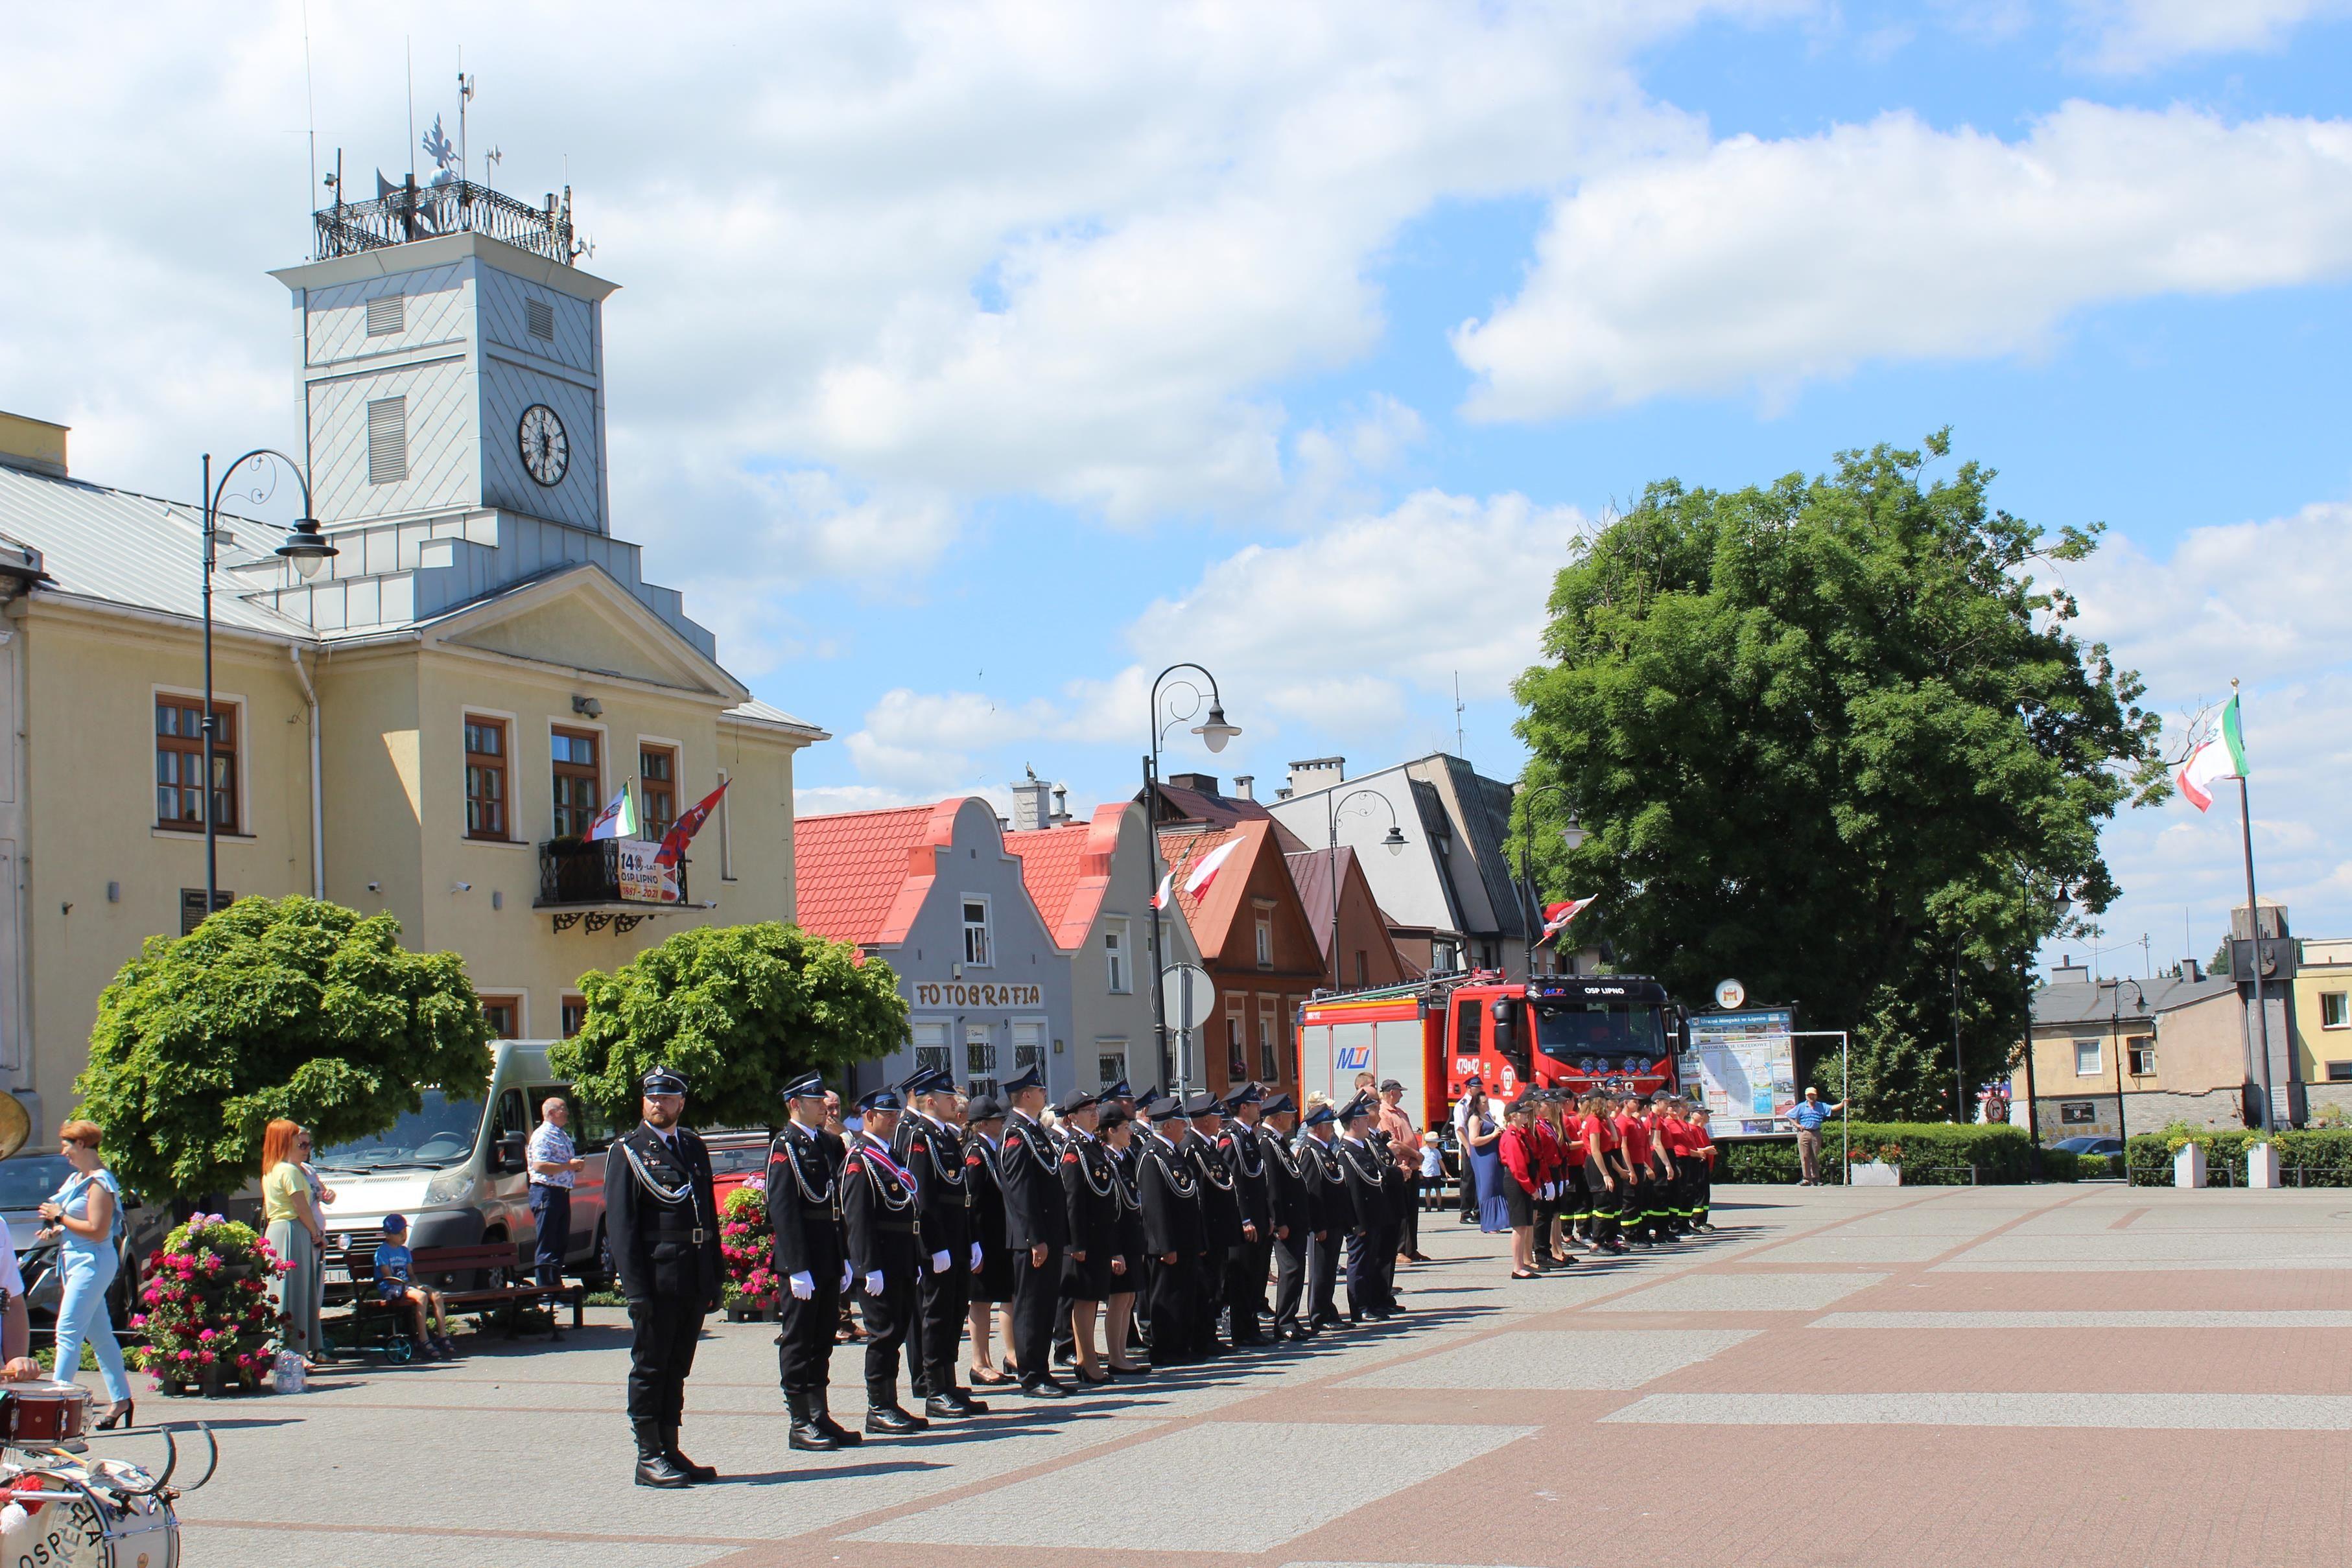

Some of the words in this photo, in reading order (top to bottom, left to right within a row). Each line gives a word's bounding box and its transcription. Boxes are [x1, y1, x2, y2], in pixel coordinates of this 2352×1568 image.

[621, 872, 635, 882] OSP
[636, 874, 658, 884] LIPNO
[642, 889, 659, 898] 2021
[917, 983, 1040, 1007] FOTOGRAFIA
[1004, 1019, 1008, 1029] 9
